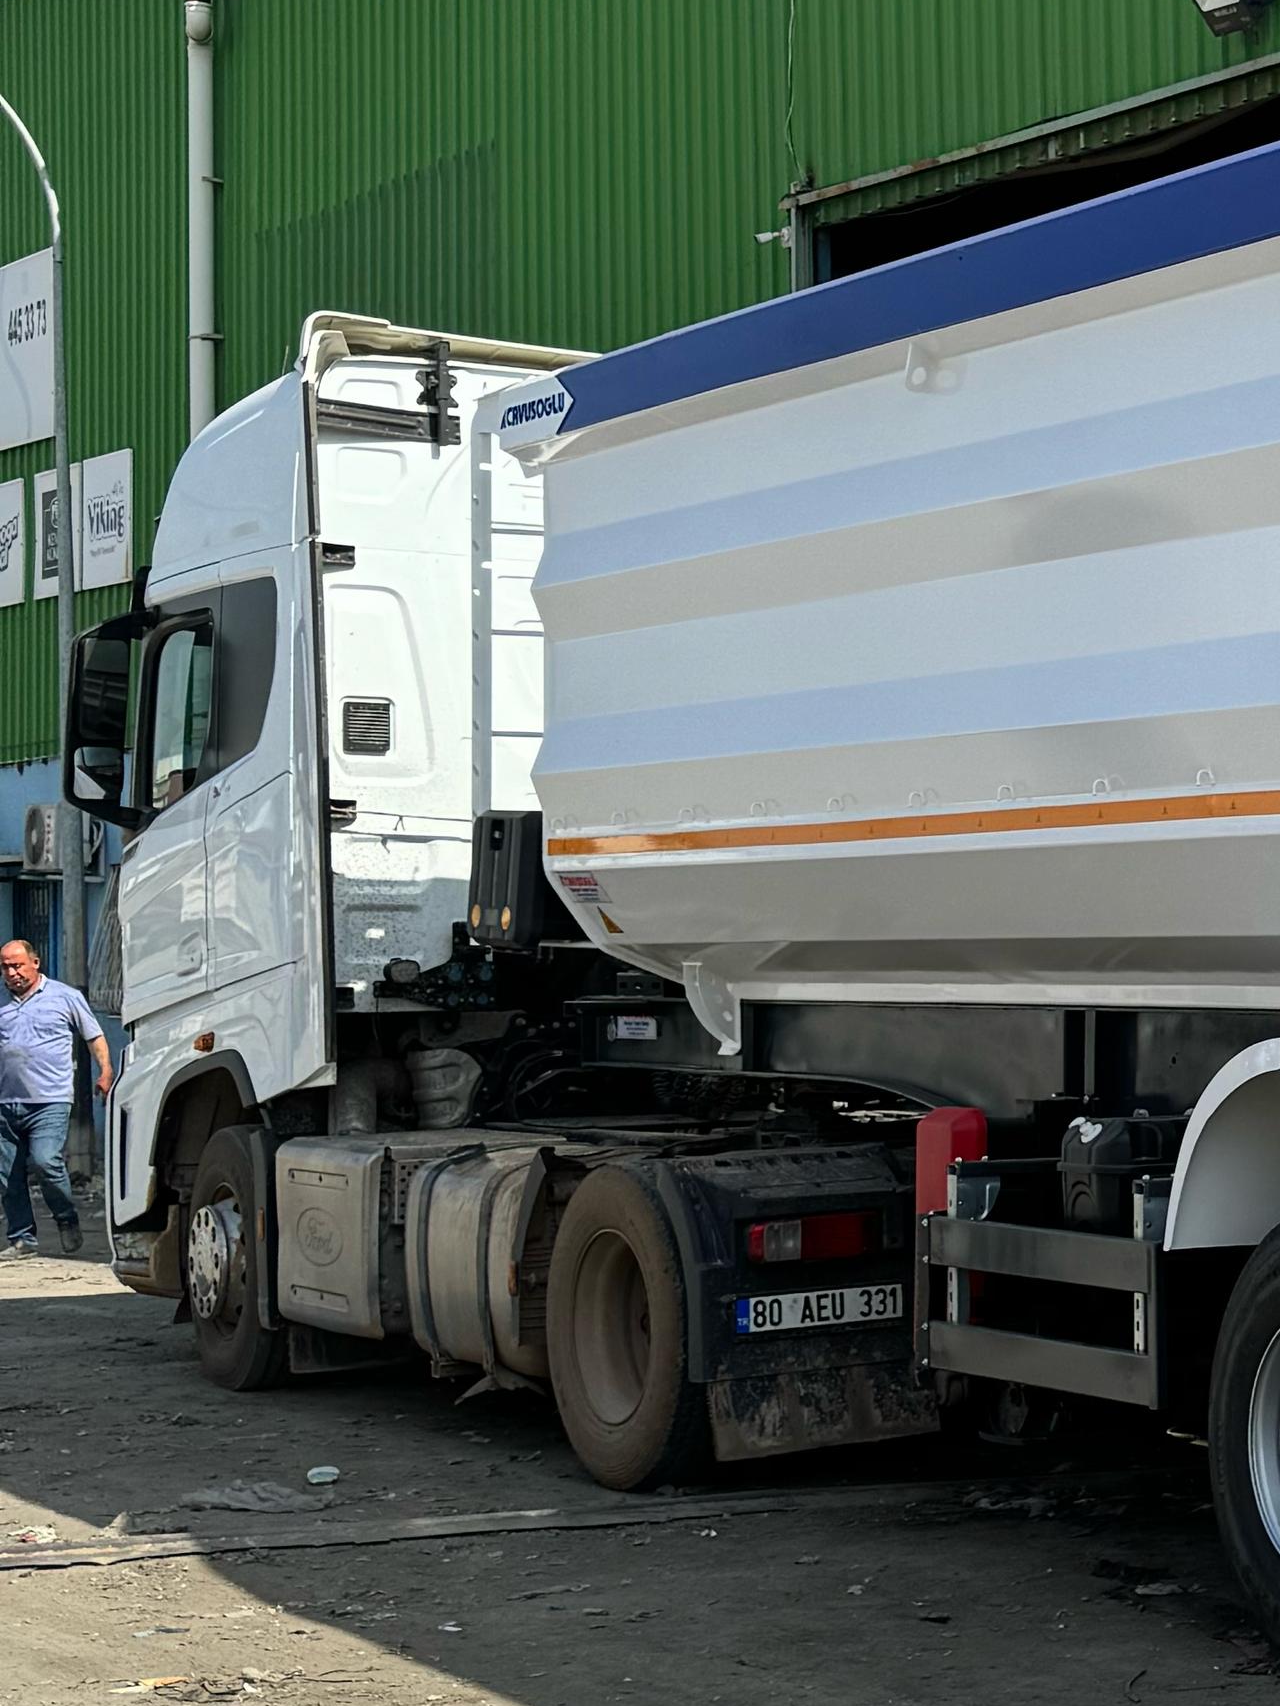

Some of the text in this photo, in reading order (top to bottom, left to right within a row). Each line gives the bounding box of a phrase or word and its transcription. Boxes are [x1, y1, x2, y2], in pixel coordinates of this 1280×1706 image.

[25, 303, 35, 341] 33
[36, 299, 47, 335] 73
[87, 498, 125, 539] Viking
[753, 1286, 898, 1328] 80 AEU 331
